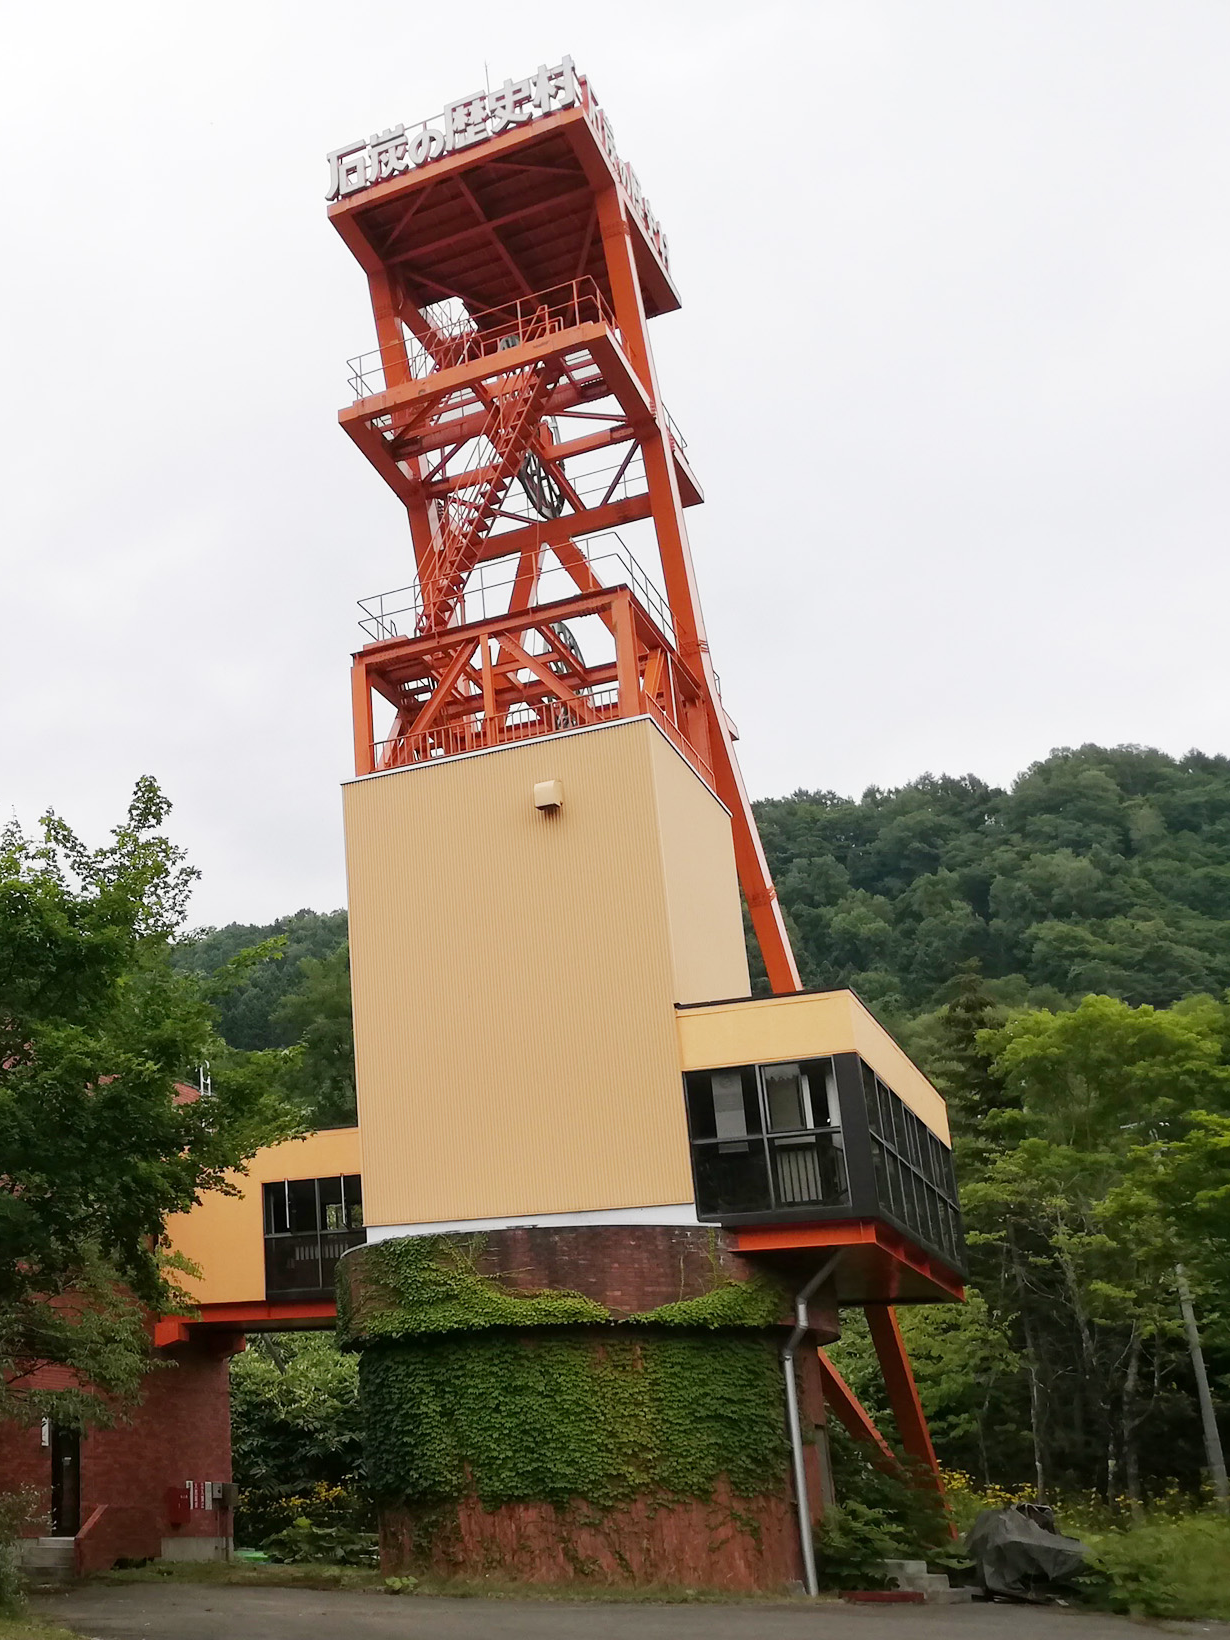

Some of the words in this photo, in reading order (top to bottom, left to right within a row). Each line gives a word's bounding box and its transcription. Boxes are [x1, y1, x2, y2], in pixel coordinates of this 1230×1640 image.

[325, 54, 576, 201] 石炭の歴史村
